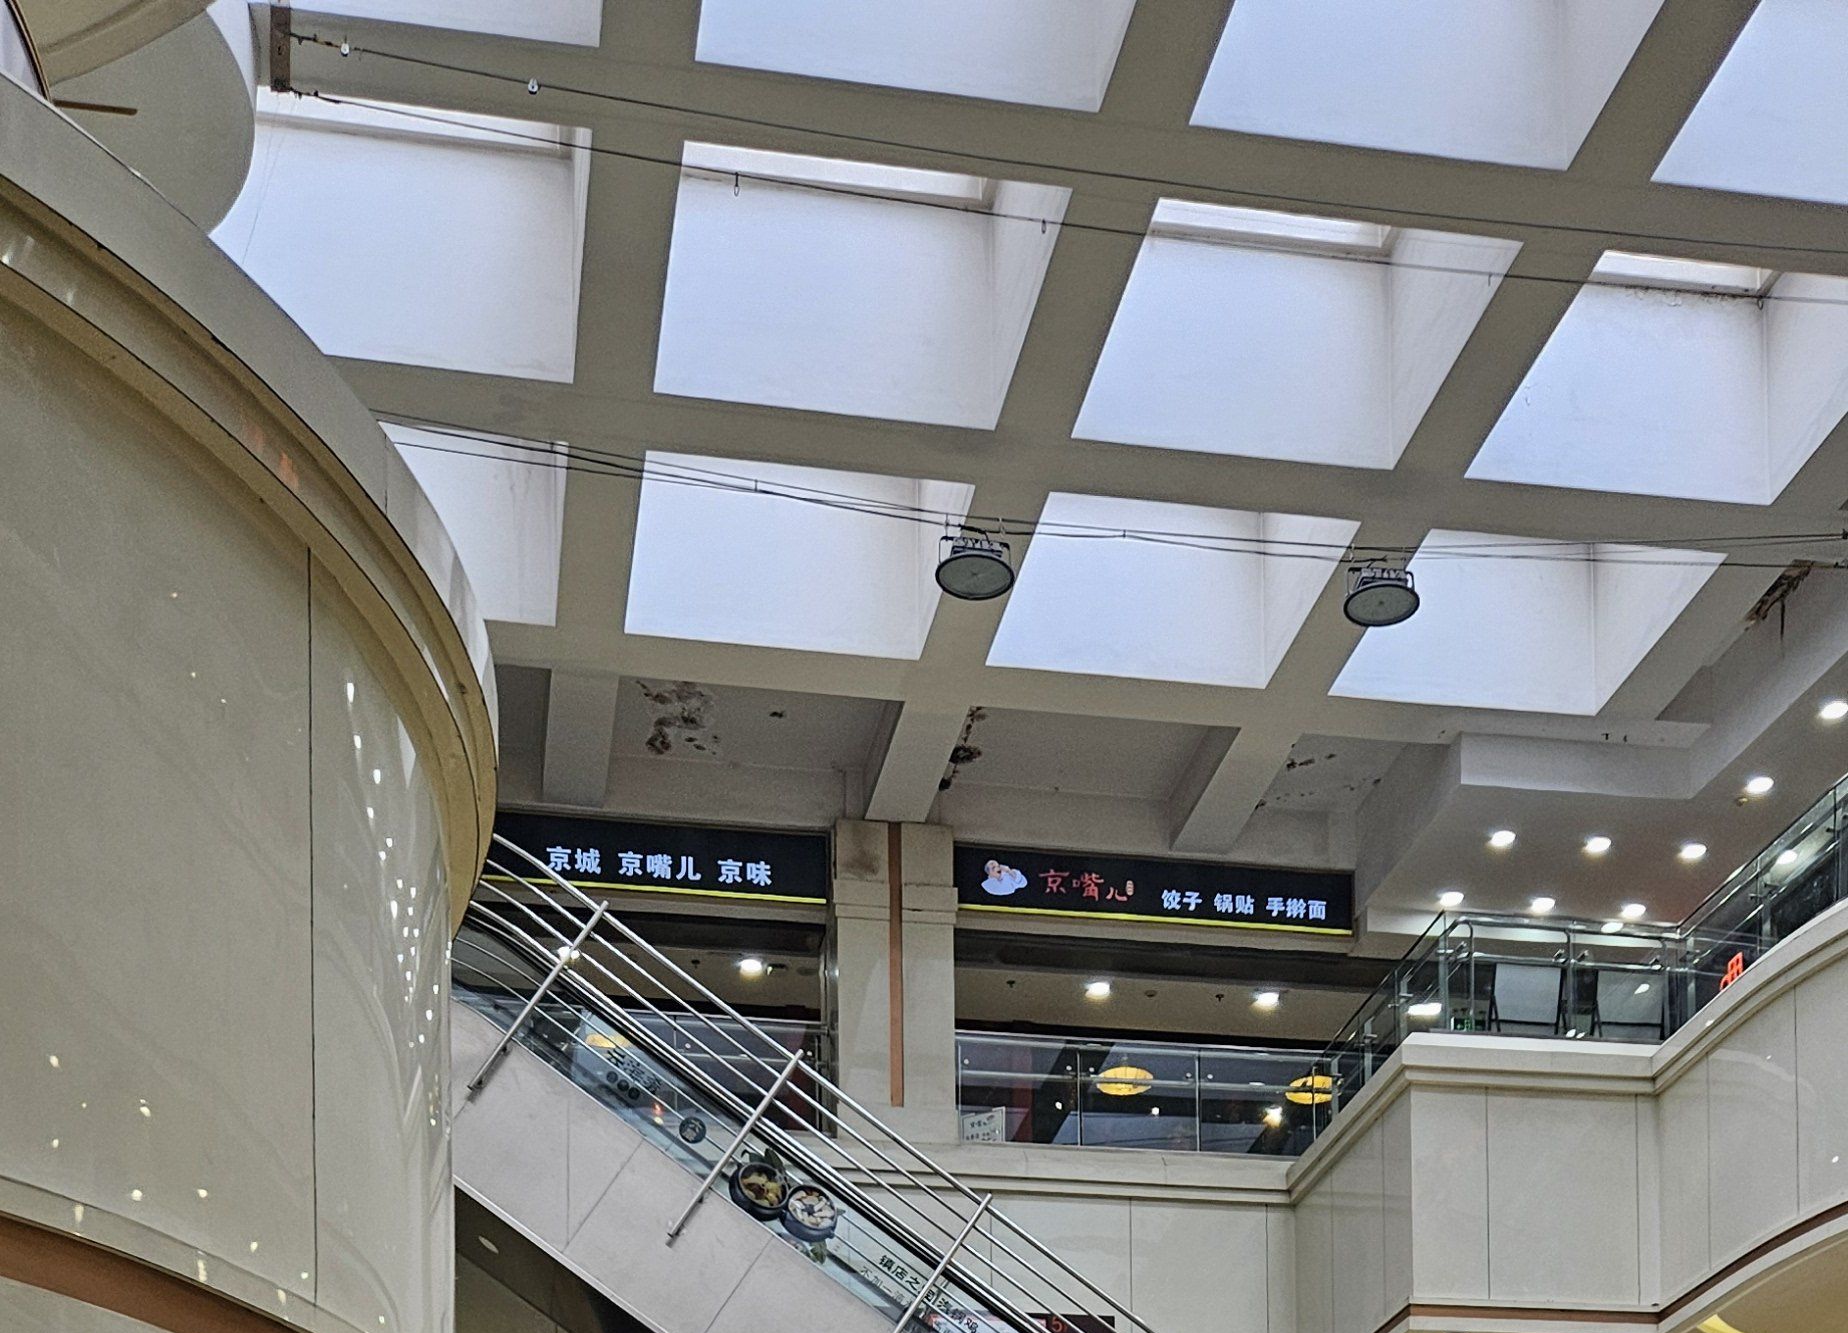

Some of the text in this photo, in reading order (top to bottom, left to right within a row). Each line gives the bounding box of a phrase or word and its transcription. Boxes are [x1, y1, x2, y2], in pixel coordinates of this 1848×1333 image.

[546, 846, 772, 887] 京城 京嘴儿 京味
[1038, 868, 1127, 902] 京嘴儿
[1161, 888, 1327, 920] 饺子 锅贴 手擀面
